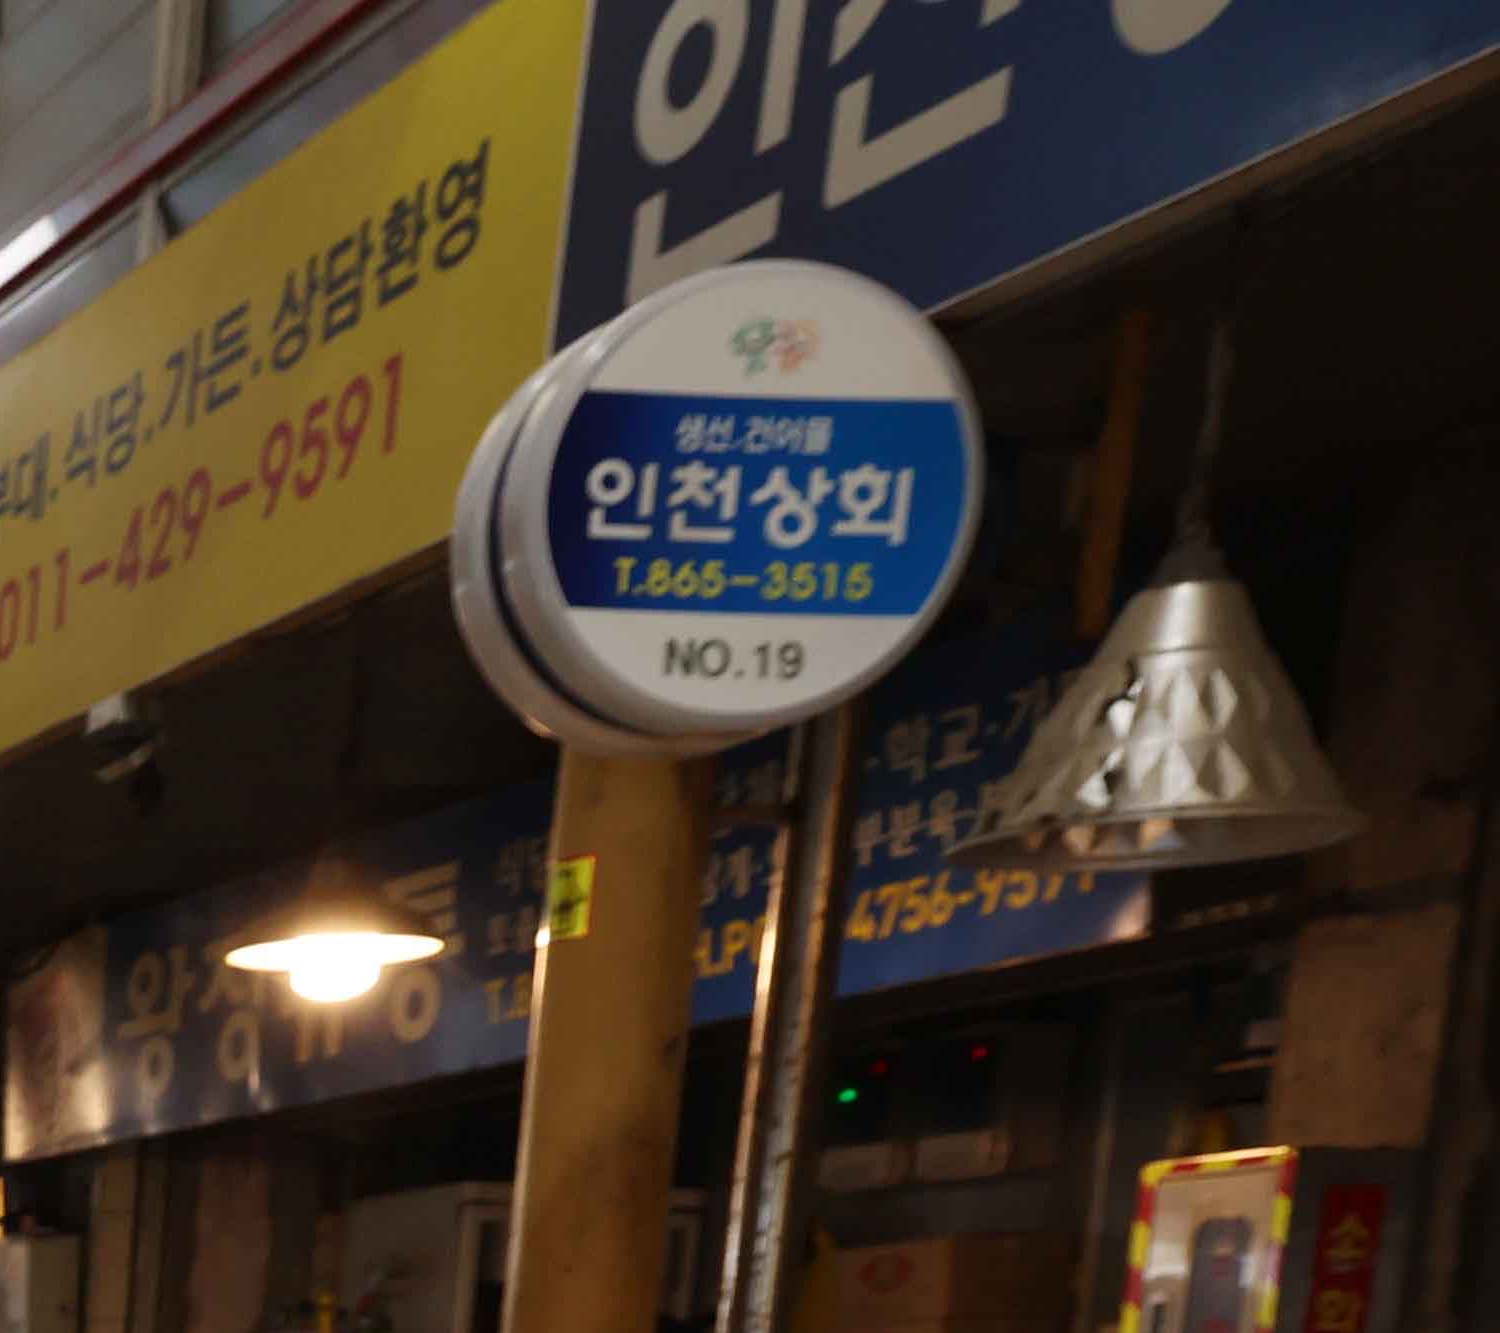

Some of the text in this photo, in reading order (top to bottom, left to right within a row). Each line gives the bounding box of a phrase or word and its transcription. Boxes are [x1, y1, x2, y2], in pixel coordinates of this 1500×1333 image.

[585, 457, 916, 550] 인천상회
[612, 556, 874, 602] T.865-3515
[663, 636, 806, 681] NO.19
